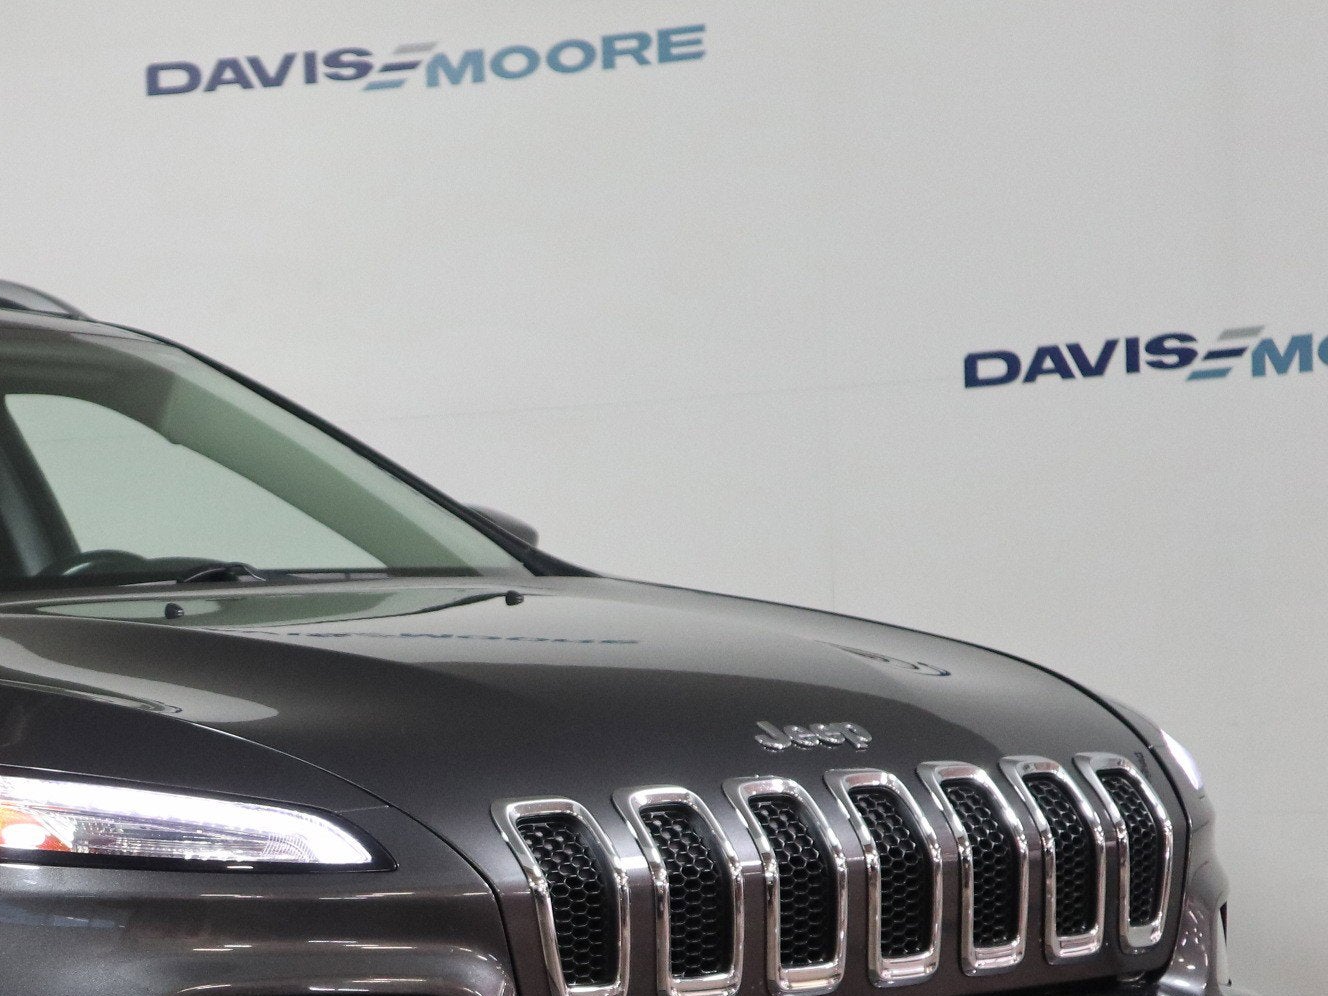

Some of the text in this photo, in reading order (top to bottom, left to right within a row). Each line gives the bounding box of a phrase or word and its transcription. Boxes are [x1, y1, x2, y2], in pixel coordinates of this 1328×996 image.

[146, 23, 707, 96] DAVIS MOORE
[964, 331, 1328, 389] DAVIS M
[754, 720, 873, 750] Jeep
